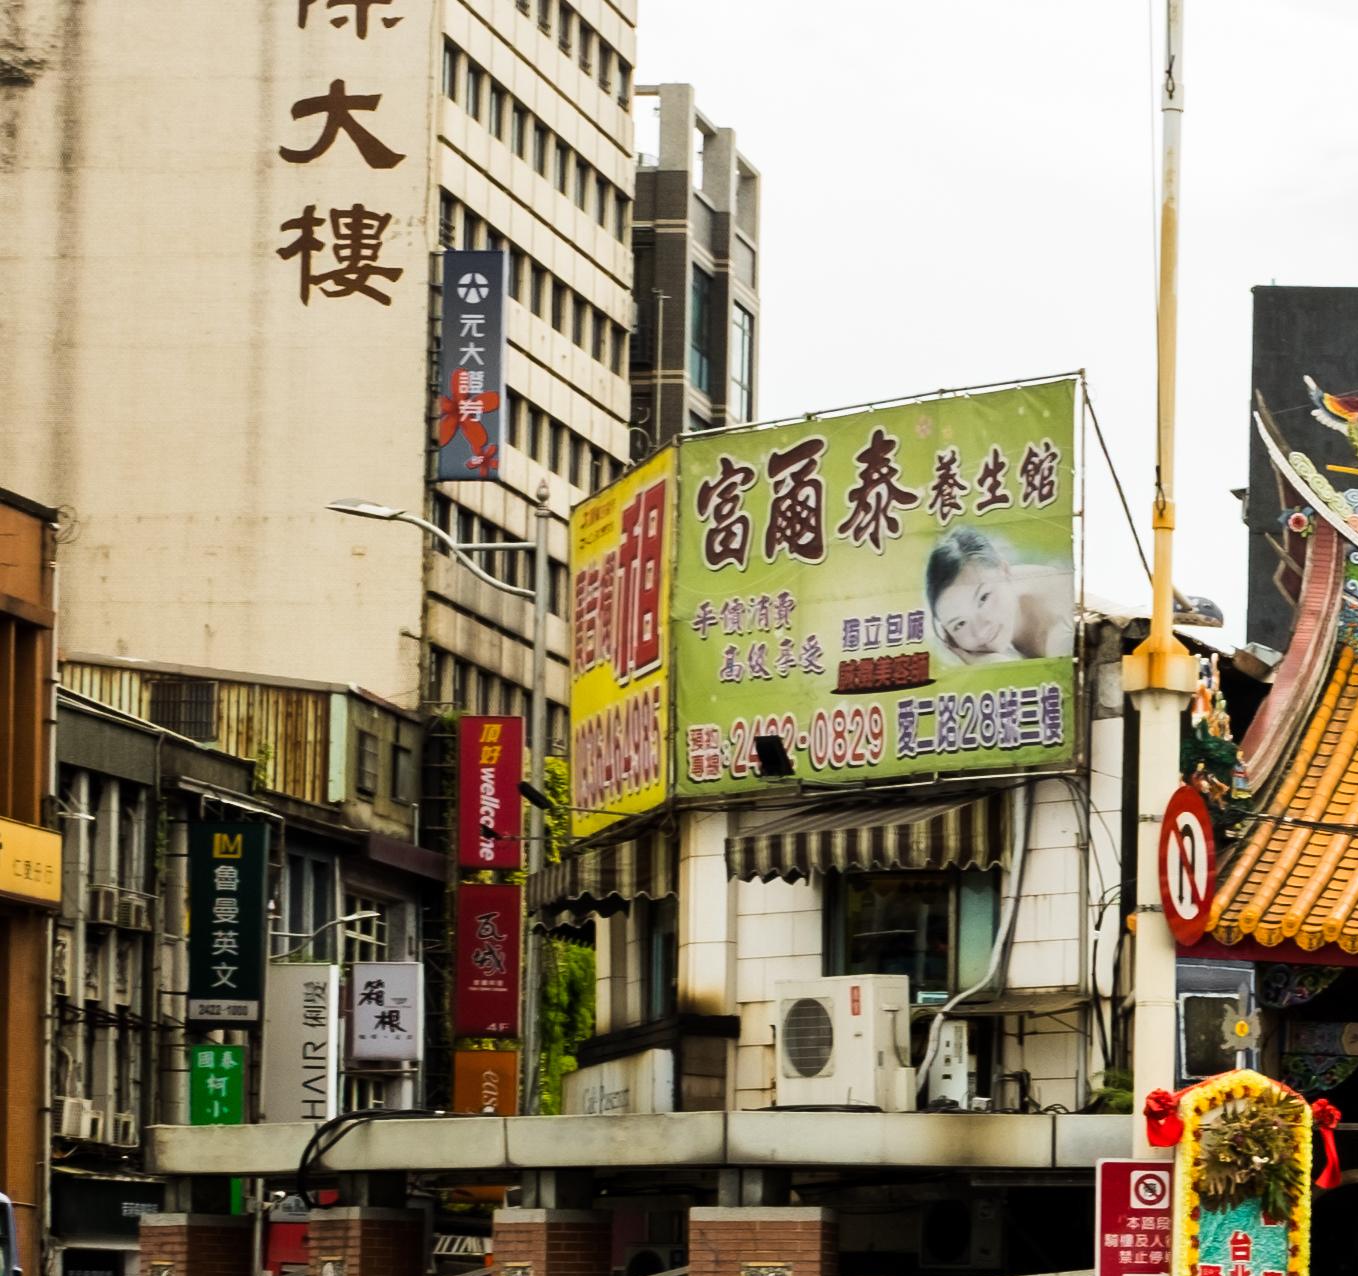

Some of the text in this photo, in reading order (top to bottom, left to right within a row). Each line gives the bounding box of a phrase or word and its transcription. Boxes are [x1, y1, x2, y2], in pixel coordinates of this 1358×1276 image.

[458, 313, 486, 422] 元大證券
[696, 427, 920, 571] 富爾泰
[926, 437, 1062, 527] 養生館
[616, 477, 668, 690] 租
[691, 590, 797, 640] 平價消費
[719, 634, 826, 684] 高級享受
[211, 865, 241, 989] 魯曼英文
[302, 1040, 327, 1120] HAIR
